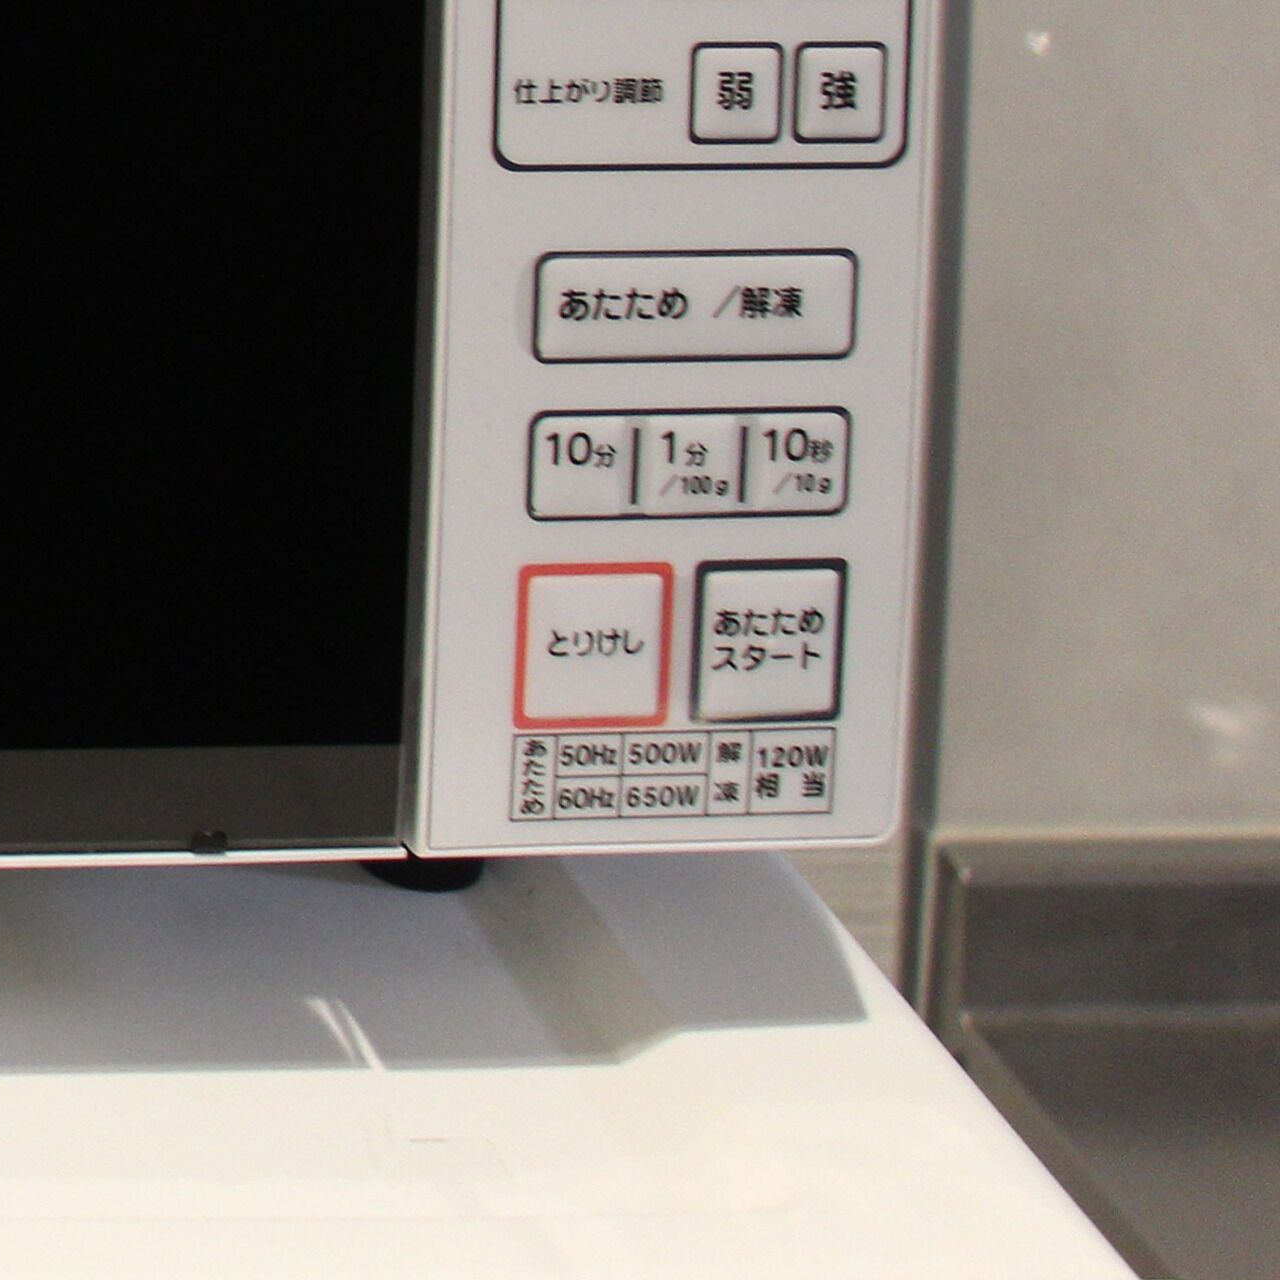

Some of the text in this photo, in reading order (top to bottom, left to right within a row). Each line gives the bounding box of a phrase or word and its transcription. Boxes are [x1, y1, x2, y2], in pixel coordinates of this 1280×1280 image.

[513, 77, 664, 105] 仕上がり調節
[716, 71, 755, 112] 弱
[819, 70, 859, 111] 強
[558, 287, 689, 322] あたため
[545, 431, 619, 469] 10分
[762, 427, 835, 464] 10秒
[712, 607, 826, 638] あたため
[547, 628, 645, 658] とりけし
[711, 641, 822, 672] スタート
[559, 743, 618, 767] 50Hz
[628, 741, 703, 766] 500W
[757, 745, 830, 769] 120W
[519, 738, 548, 816] あたため
[712, 741, 744, 803] 解凍
[753, 771, 827, 800] 相当
[556, 787, 615, 810] 60Hz
[626, 785, 700, 809] 650W
